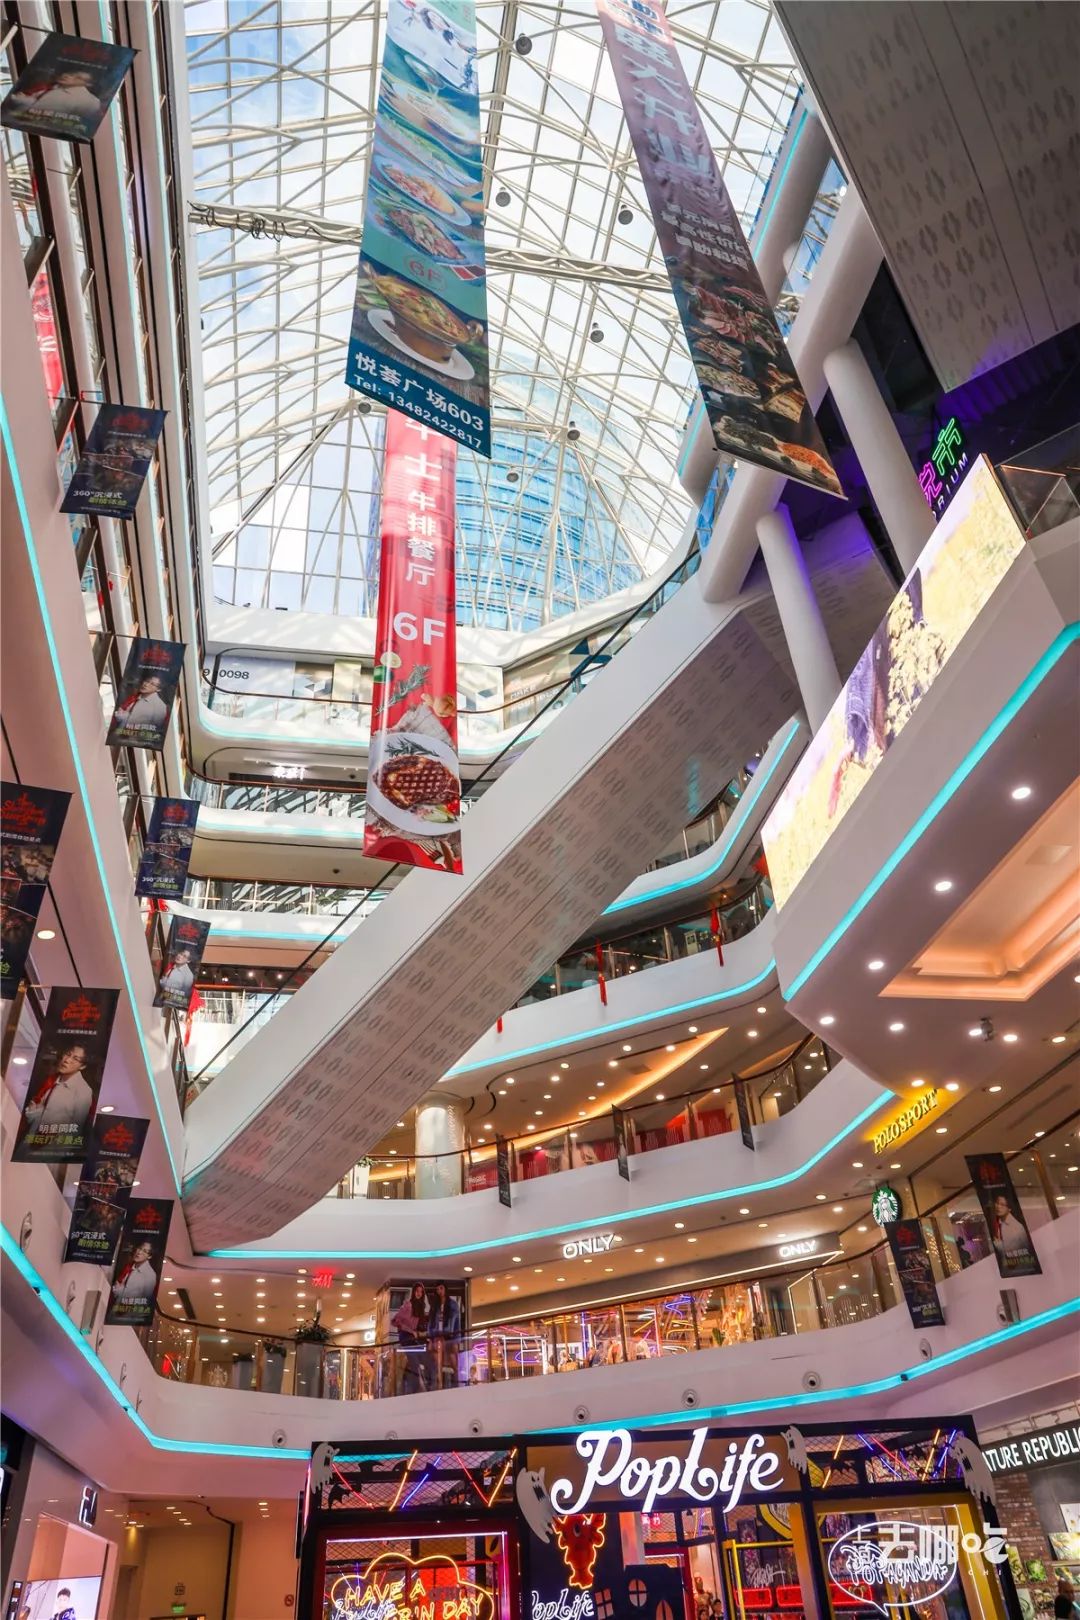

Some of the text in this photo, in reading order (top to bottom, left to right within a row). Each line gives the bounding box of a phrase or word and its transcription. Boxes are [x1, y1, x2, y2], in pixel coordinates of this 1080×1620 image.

[355, 352, 484, 431] 悦荟广场603
[353, 374, 482, 449] Tel: 13482422817
[393, 612, 447, 646] 6F
[562, 1233, 615, 1260] ONLY
[779, 1240, 816, 1259] ONLY
[550, 1426, 784, 1516] PopLife
[345, 1579, 403, 1612] HAVE
[410, 1578, 426, 1599] A
[442, 1592, 484, 1620] DAY
